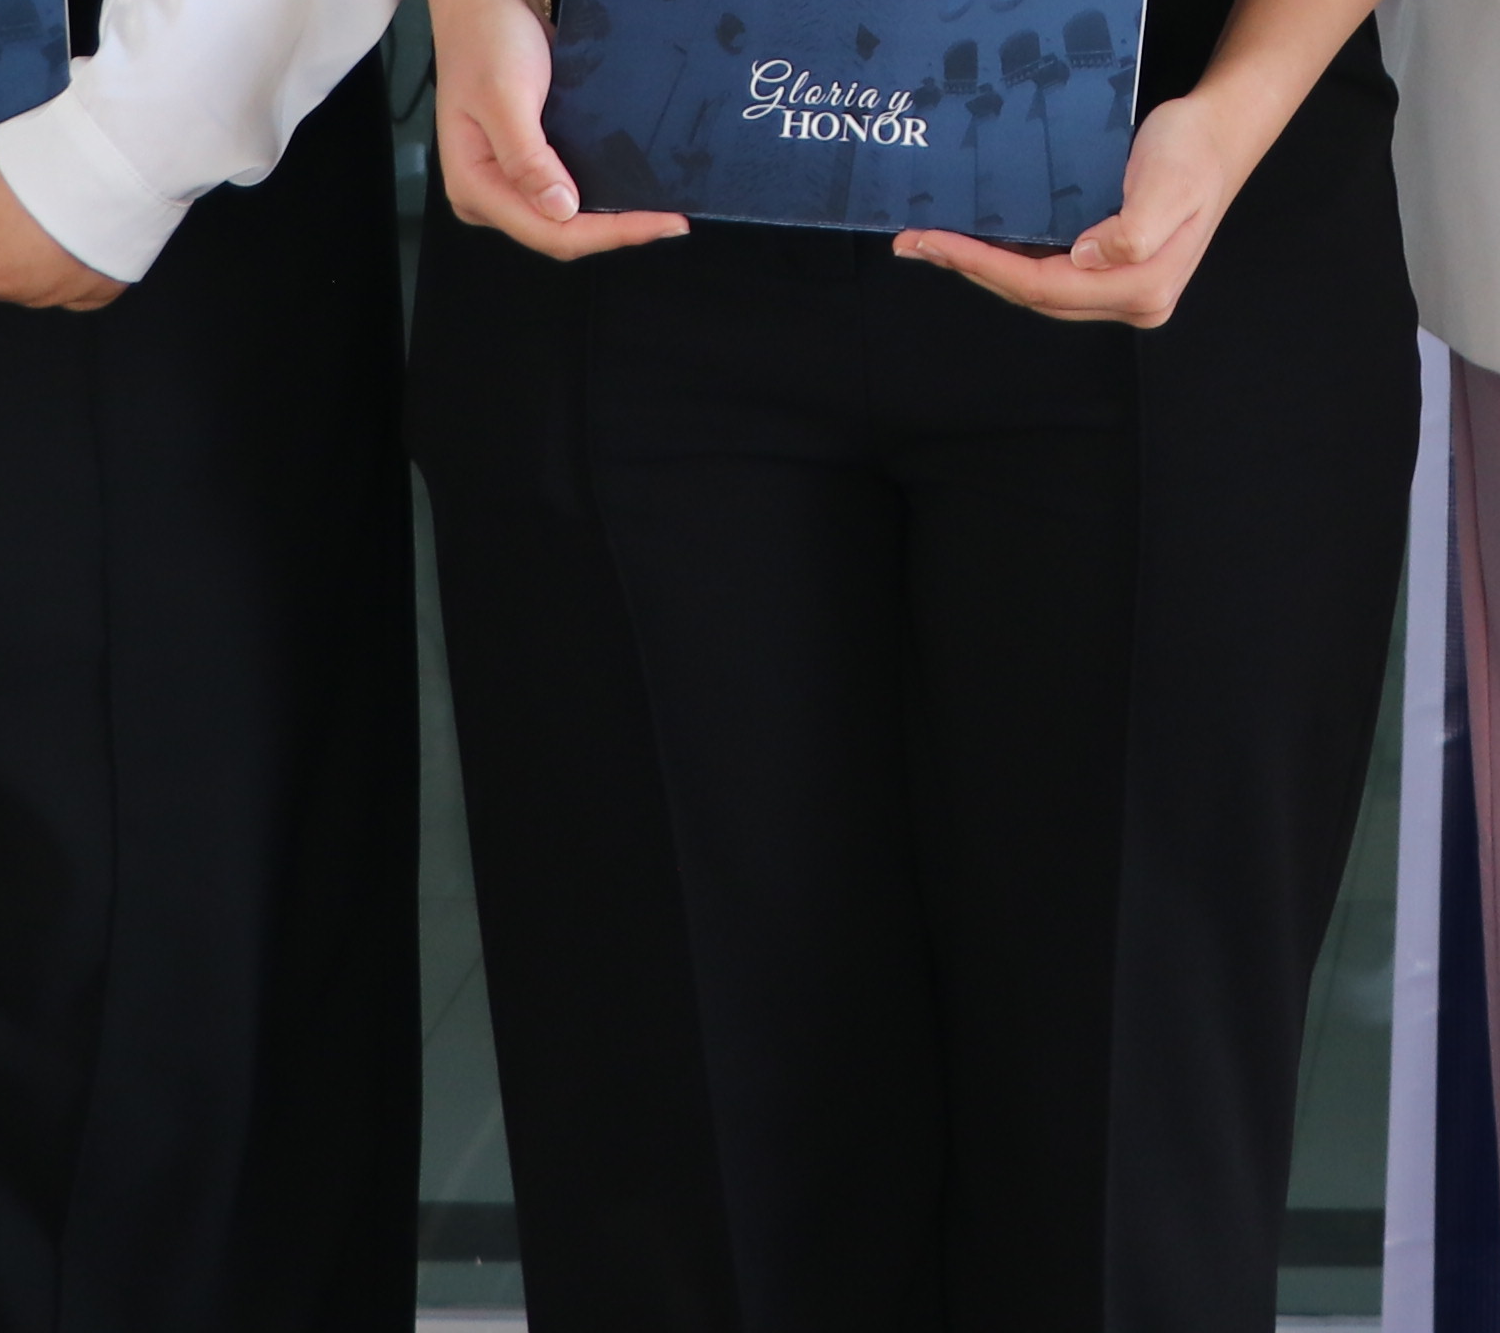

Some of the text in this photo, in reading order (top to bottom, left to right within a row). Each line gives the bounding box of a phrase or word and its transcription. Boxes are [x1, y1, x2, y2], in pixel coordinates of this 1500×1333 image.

[742, 59, 914, 125] Gloria y
[779, 109, 929, 147] HONOR
